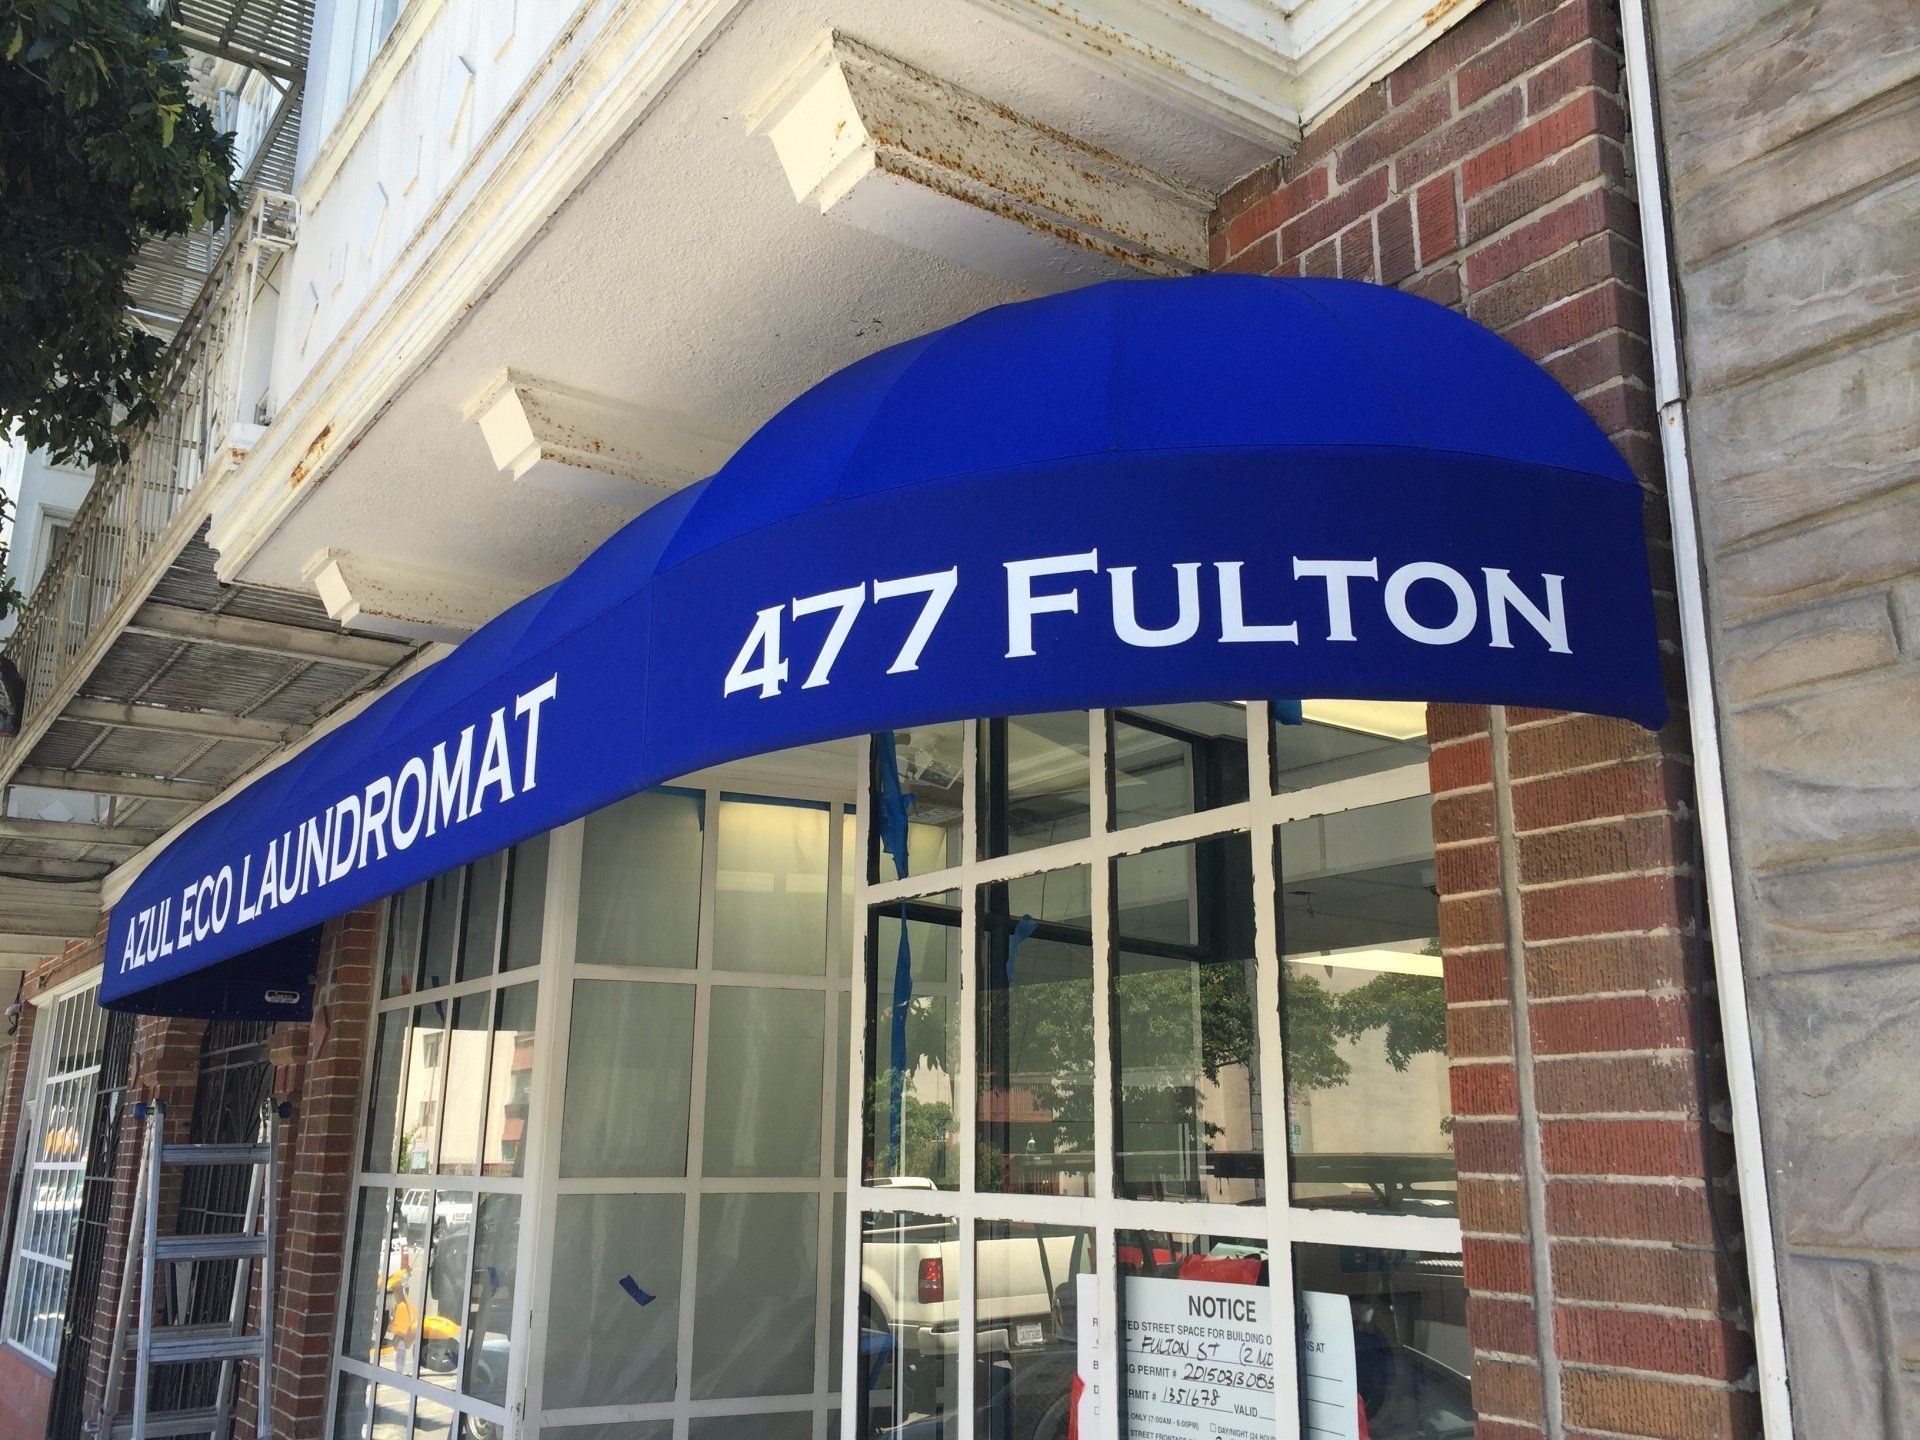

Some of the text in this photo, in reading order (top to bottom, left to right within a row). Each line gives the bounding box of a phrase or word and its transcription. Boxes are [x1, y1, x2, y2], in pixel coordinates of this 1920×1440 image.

[724, 547, 1573, 700] 477 FULTON
[120, 672, 558, 974] AZUL ECO LAUNDROMAT
[1188, 1295, 1257, 1323] NOTICE
[1141, 1321, 1175, 1334] STREET
[1177, 1325, 1205, 1337] SPACE
[1207, 1328, 1225, 1340] FOR
[1227, 1331, 1264, 1344] BUILDING
[1315, 1342, 1325, 1353] AT
[1141, 1335, 1190, 1356] FULTON
[1137, 1364, 1170, 1378] PERMIT
[1130, 1412, 1147, 1421] ONLY
[1233, 1404, 1258, 1417] VALID
[1130, 1429, 1154, 1439] STREET
